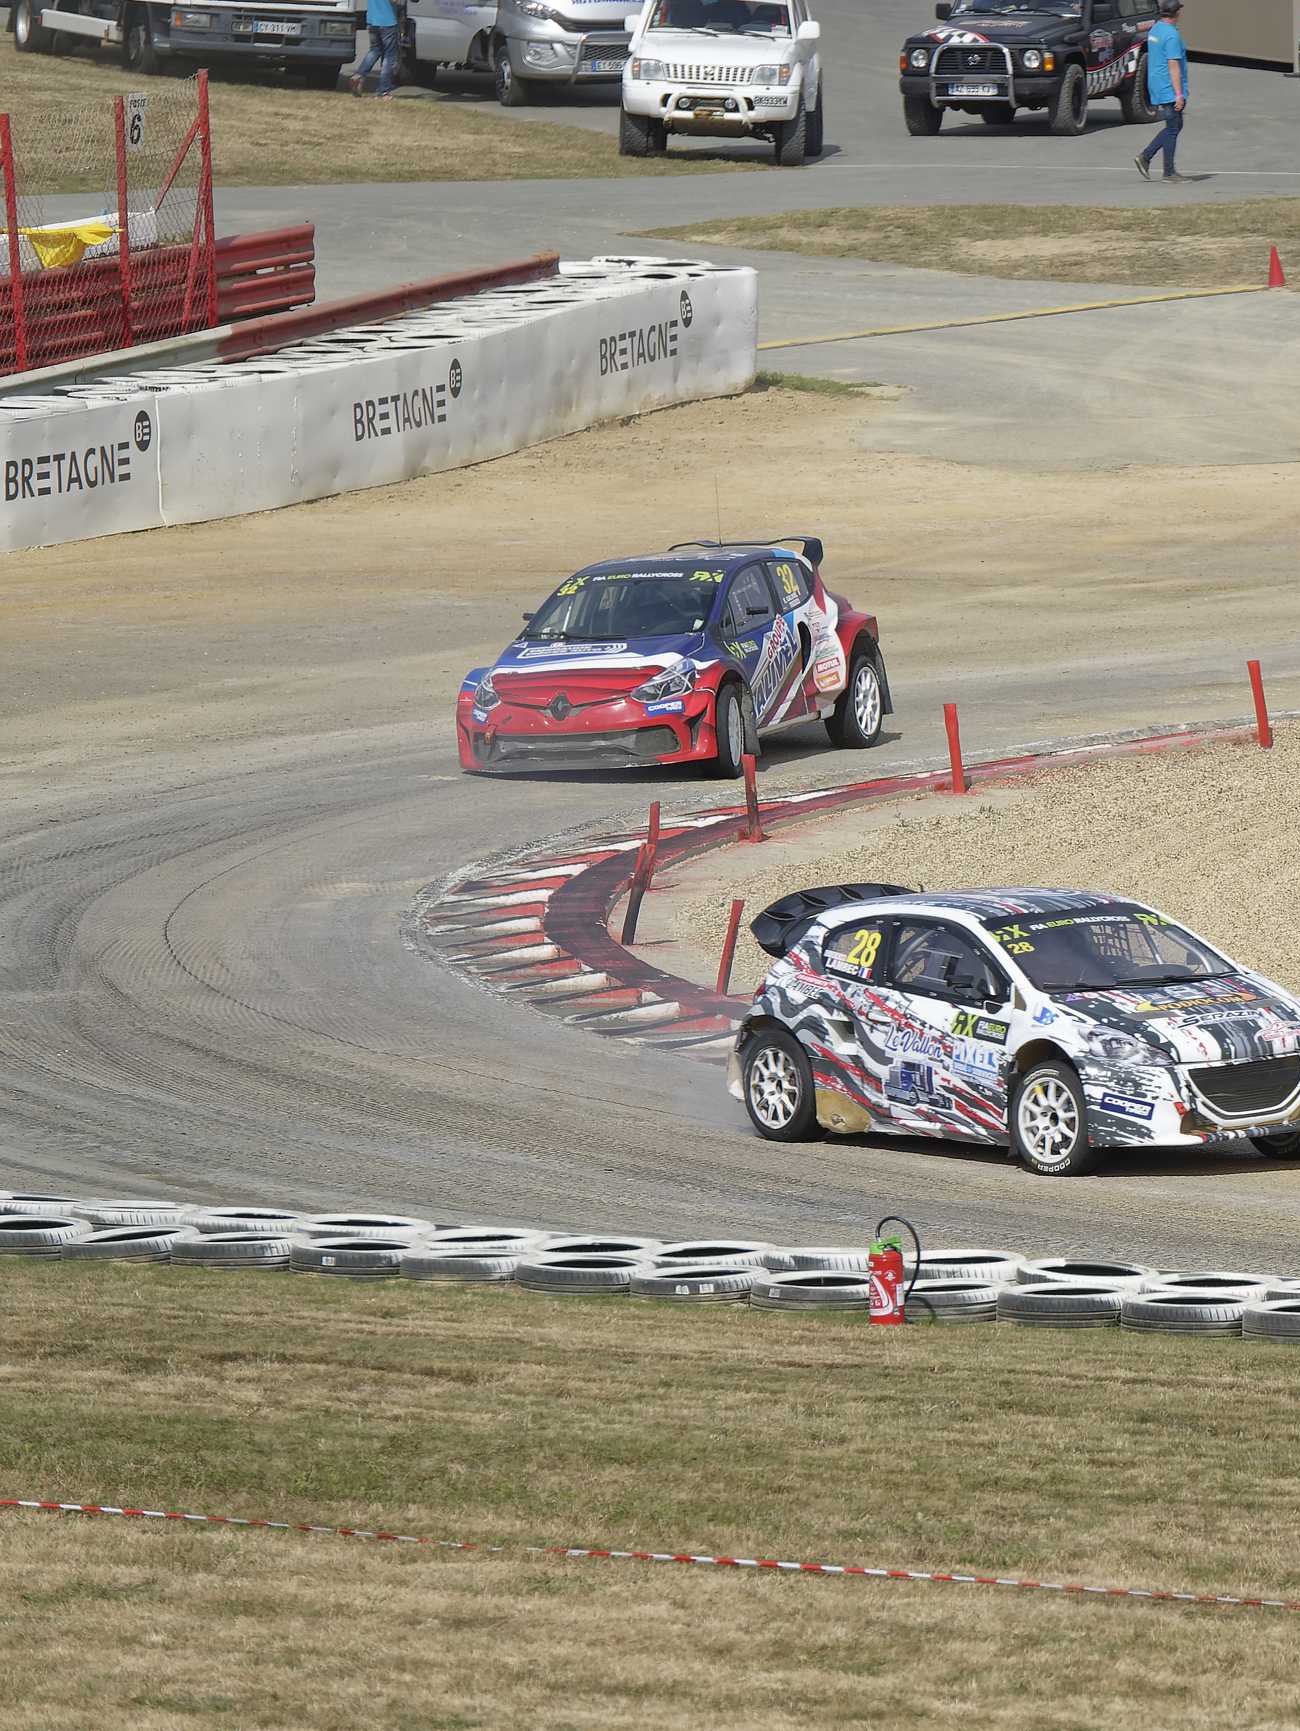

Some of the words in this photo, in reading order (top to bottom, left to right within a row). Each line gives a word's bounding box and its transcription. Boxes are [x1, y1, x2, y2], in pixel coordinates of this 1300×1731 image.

[130, 113, 142, 144] 6
[599, 320, 678, 376] BRETAGNE
[353, 384, 447, 441] BRETAGNE
[5, 441, 131, 501] BRETAGNE
[607, 573, 631, 581] EURO
[776, 564, 799, 593] 32
[1046, 919, 1074, 928] EURO
[1073, 916, 1131, 924] RALLYCROSS
[847, 929, 882, 968] 28
[1007, 941, 1035, 955] 28
[1104, 1096, 1152, 1111] COOPER
